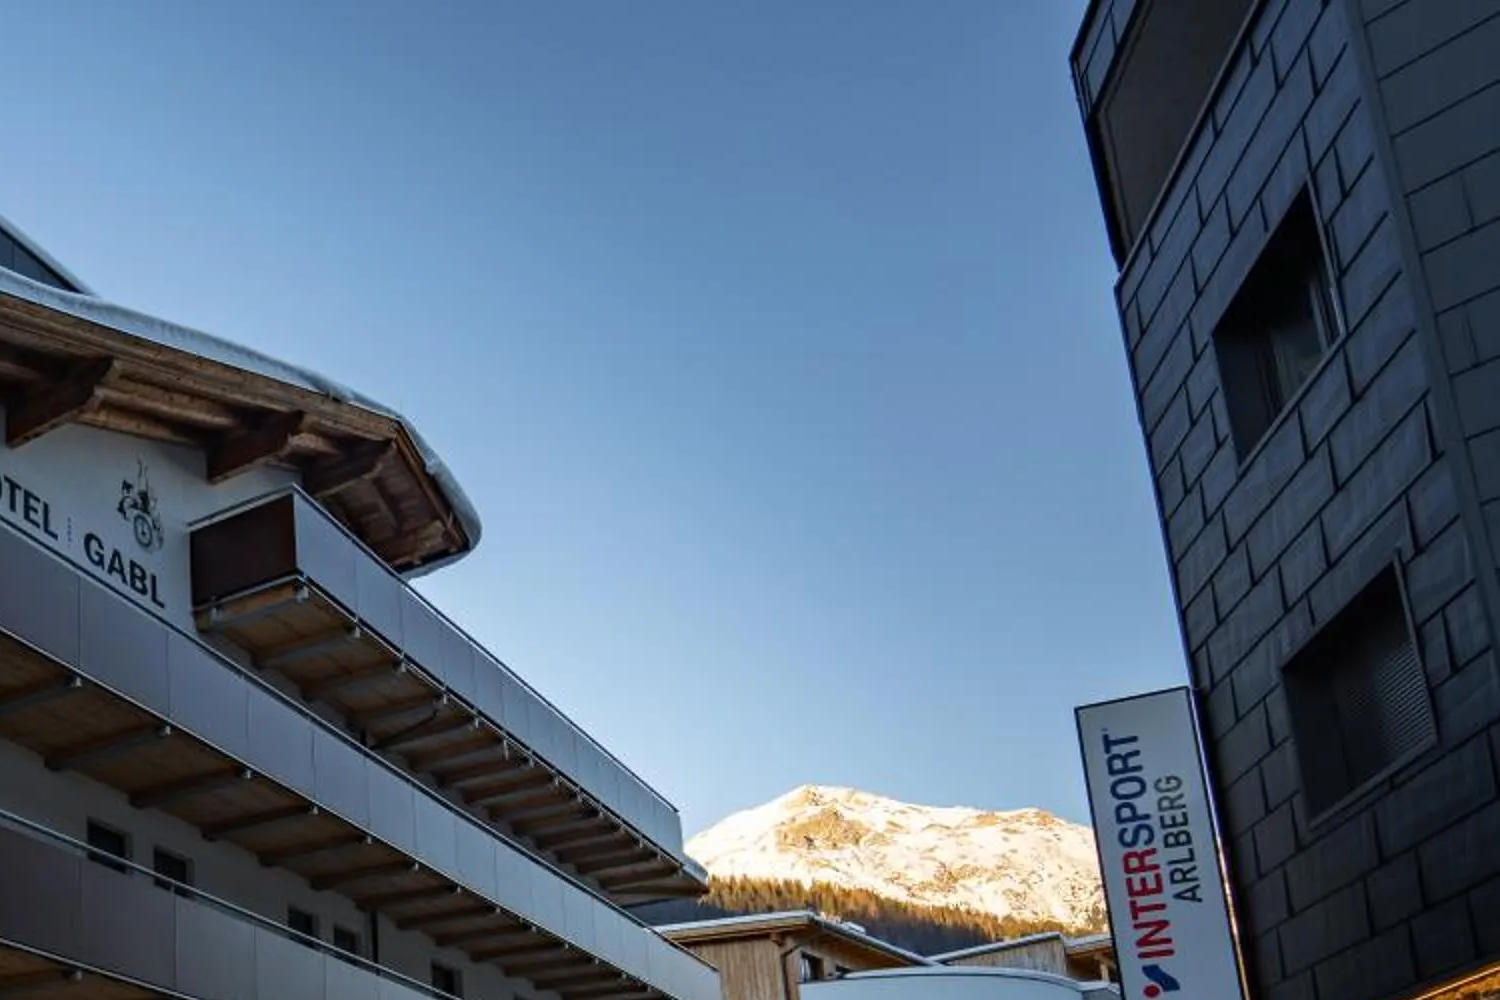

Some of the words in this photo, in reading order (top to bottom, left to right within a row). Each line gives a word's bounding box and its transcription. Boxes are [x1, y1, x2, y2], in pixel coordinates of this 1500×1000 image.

[83, 533, 165, 609] GABL
[1102, 730, 1175, 960] INTERSPORT
[1154, 774, 1203, 903] ARLBERG
